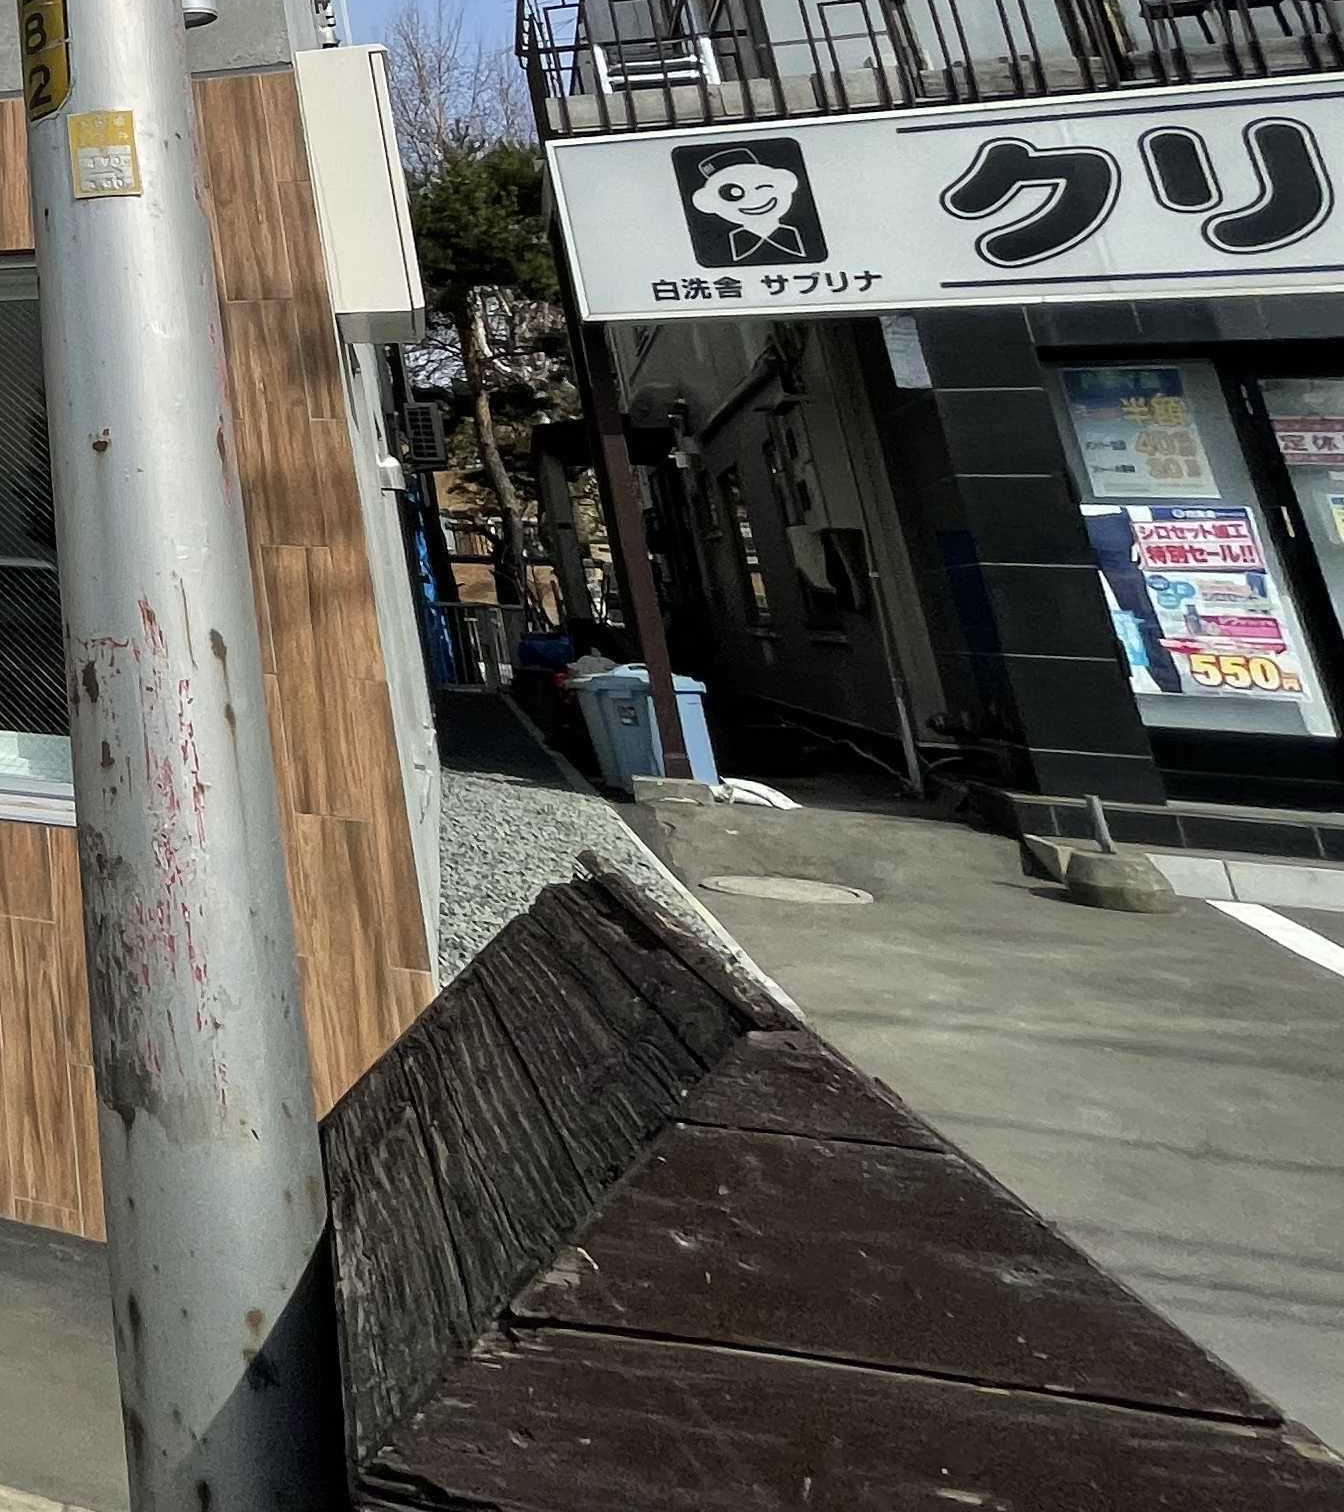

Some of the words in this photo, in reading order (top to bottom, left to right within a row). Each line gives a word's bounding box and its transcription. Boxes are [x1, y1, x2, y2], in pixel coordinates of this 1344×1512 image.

[651, 275, 743, 302] 白洗舎
[760, 270, 883, 296] サブリナ
[1278, 433, 1344, 453] 定休
